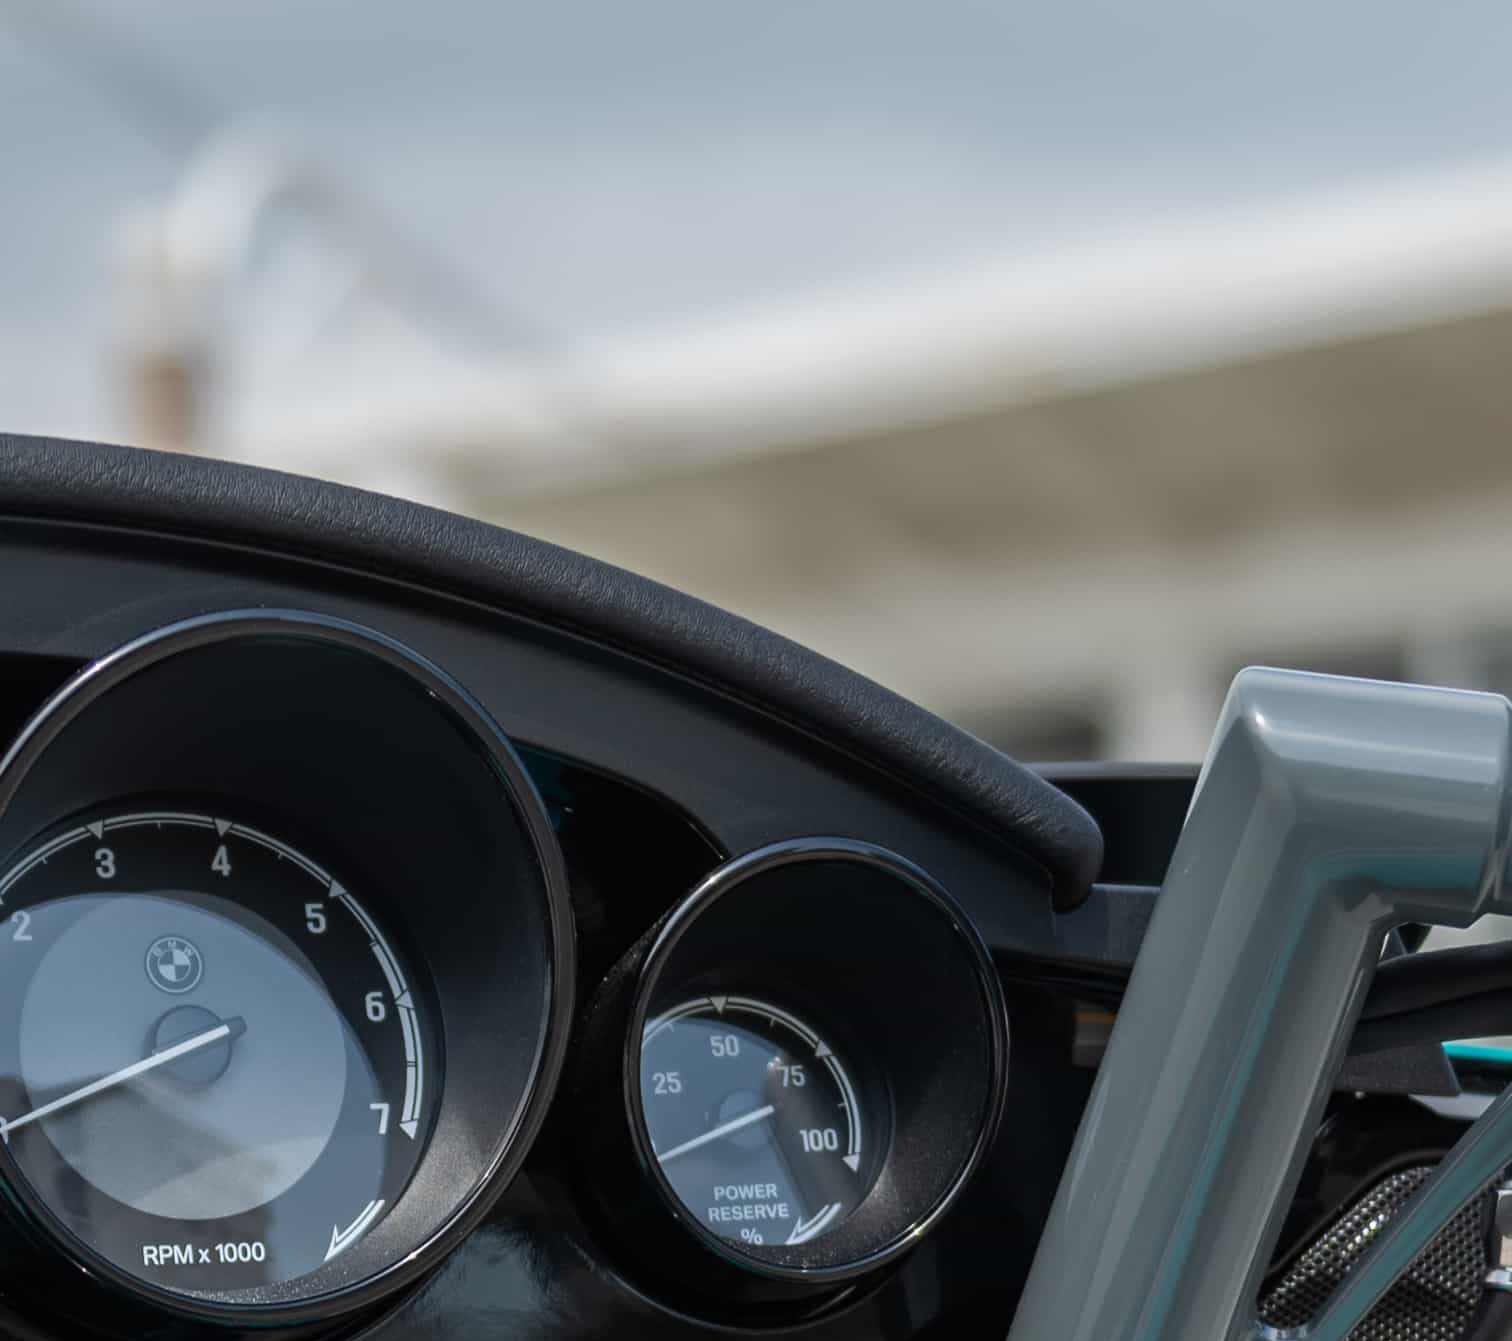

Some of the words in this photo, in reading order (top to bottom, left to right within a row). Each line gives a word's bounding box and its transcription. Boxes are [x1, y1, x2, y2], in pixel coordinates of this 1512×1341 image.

[95, 849, 117, 878] 3
[211, 845, 232, 877] 4
[11, 912, 33, 941] 2
[305, 904, 327, 933] 5
[365, 992, 386, 1021] 6
[710, 1035, 740, 1057] 50
[652, 1072, 682, 1094] 25
[779, 1065, 805, 1087] 75
[369, 1103, 390, 1134] 7
[800, 1128, 839, 1152] 100
[713, 1183, 778, 1201] POWER
[708, 1203, 790, 1222] RESERVE
[143, 1245, 194, 1266] RPM
[198, 1249, 211, 1265] x
[214, 1242, 266, 1264] 1000
